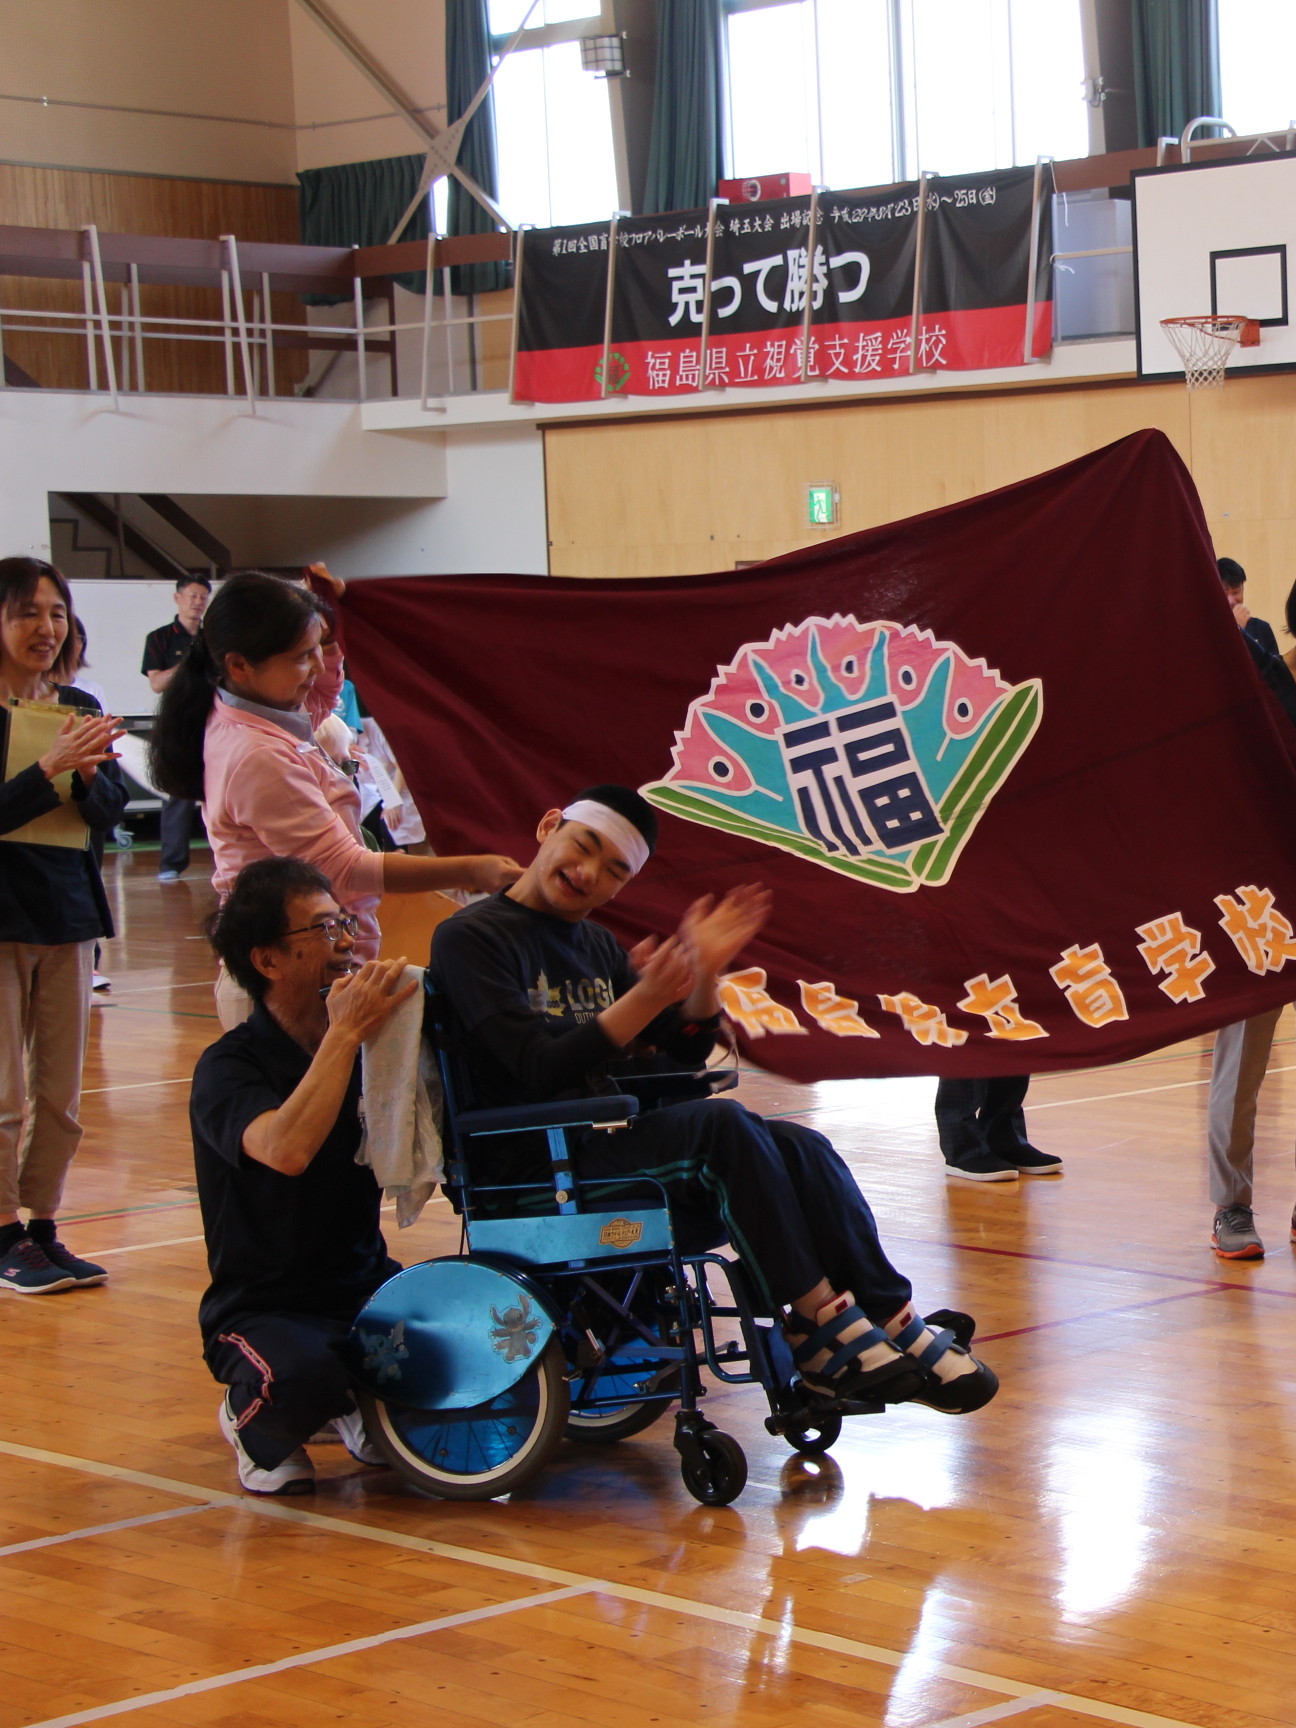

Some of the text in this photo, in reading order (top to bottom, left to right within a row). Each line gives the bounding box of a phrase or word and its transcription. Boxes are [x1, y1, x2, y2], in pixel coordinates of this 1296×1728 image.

[667, 244, 871, 328] 克って勝つ
[783, 701, 945, 856] 福
